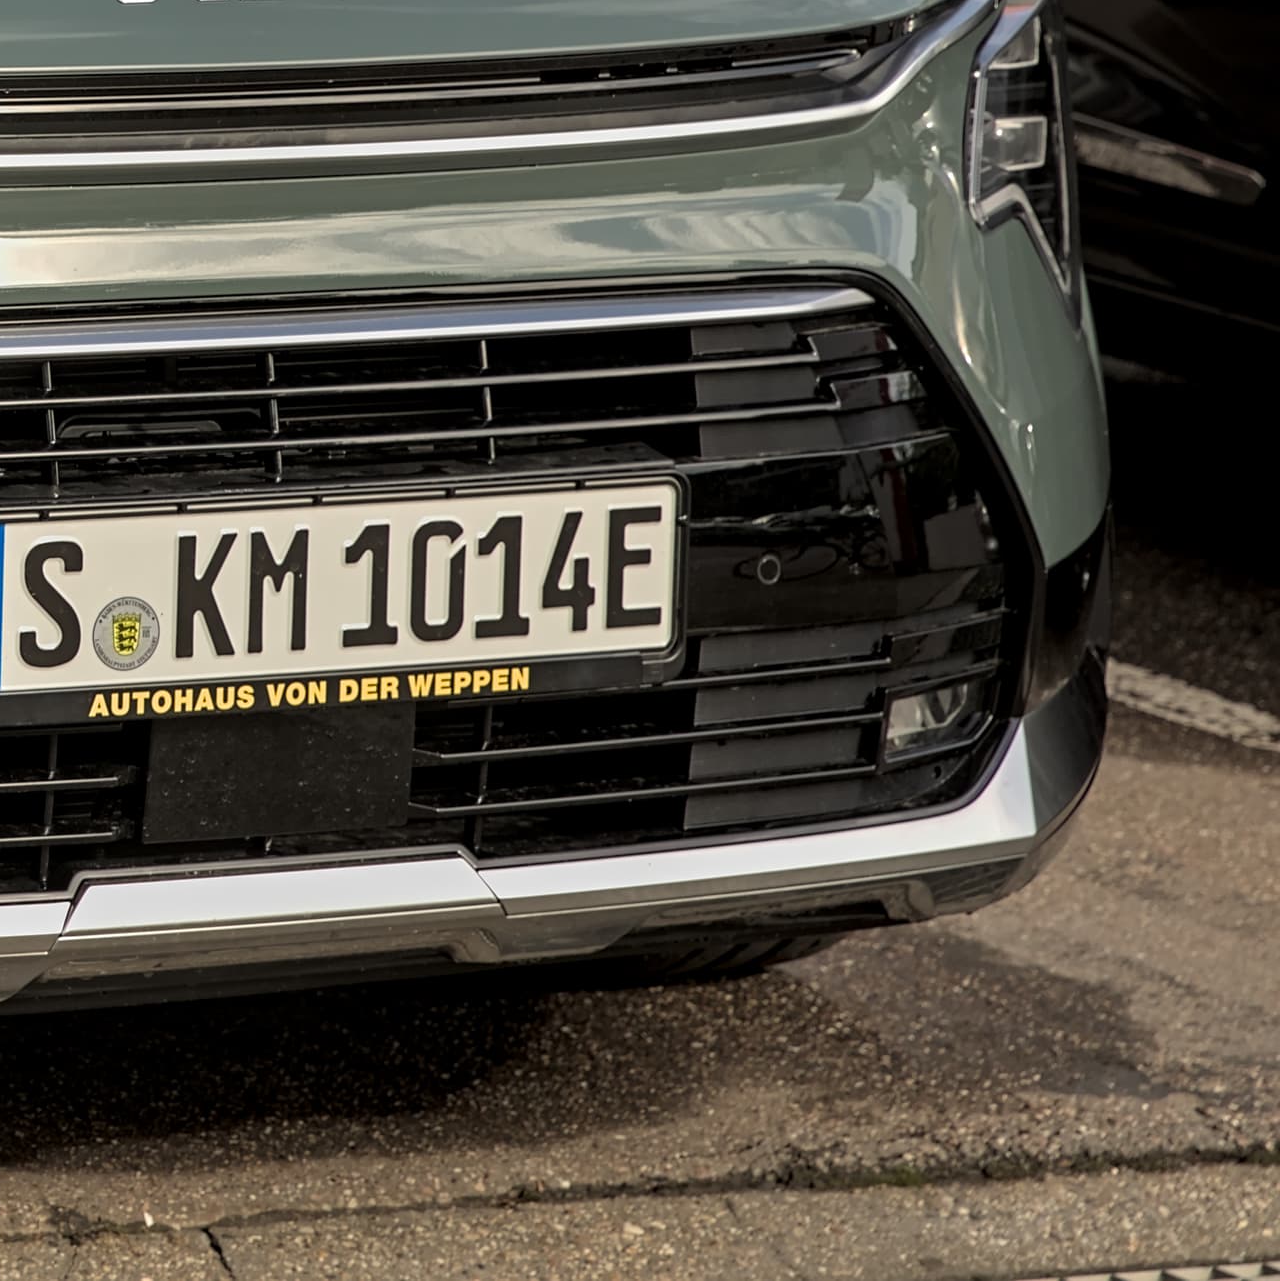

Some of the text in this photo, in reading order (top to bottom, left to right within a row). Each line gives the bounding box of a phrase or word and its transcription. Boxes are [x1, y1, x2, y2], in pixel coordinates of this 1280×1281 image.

[18, 505, 662, 668] S KM 1014E
[88, 667, 530, 718] AUTOHAUS VON DER WEPPEN
